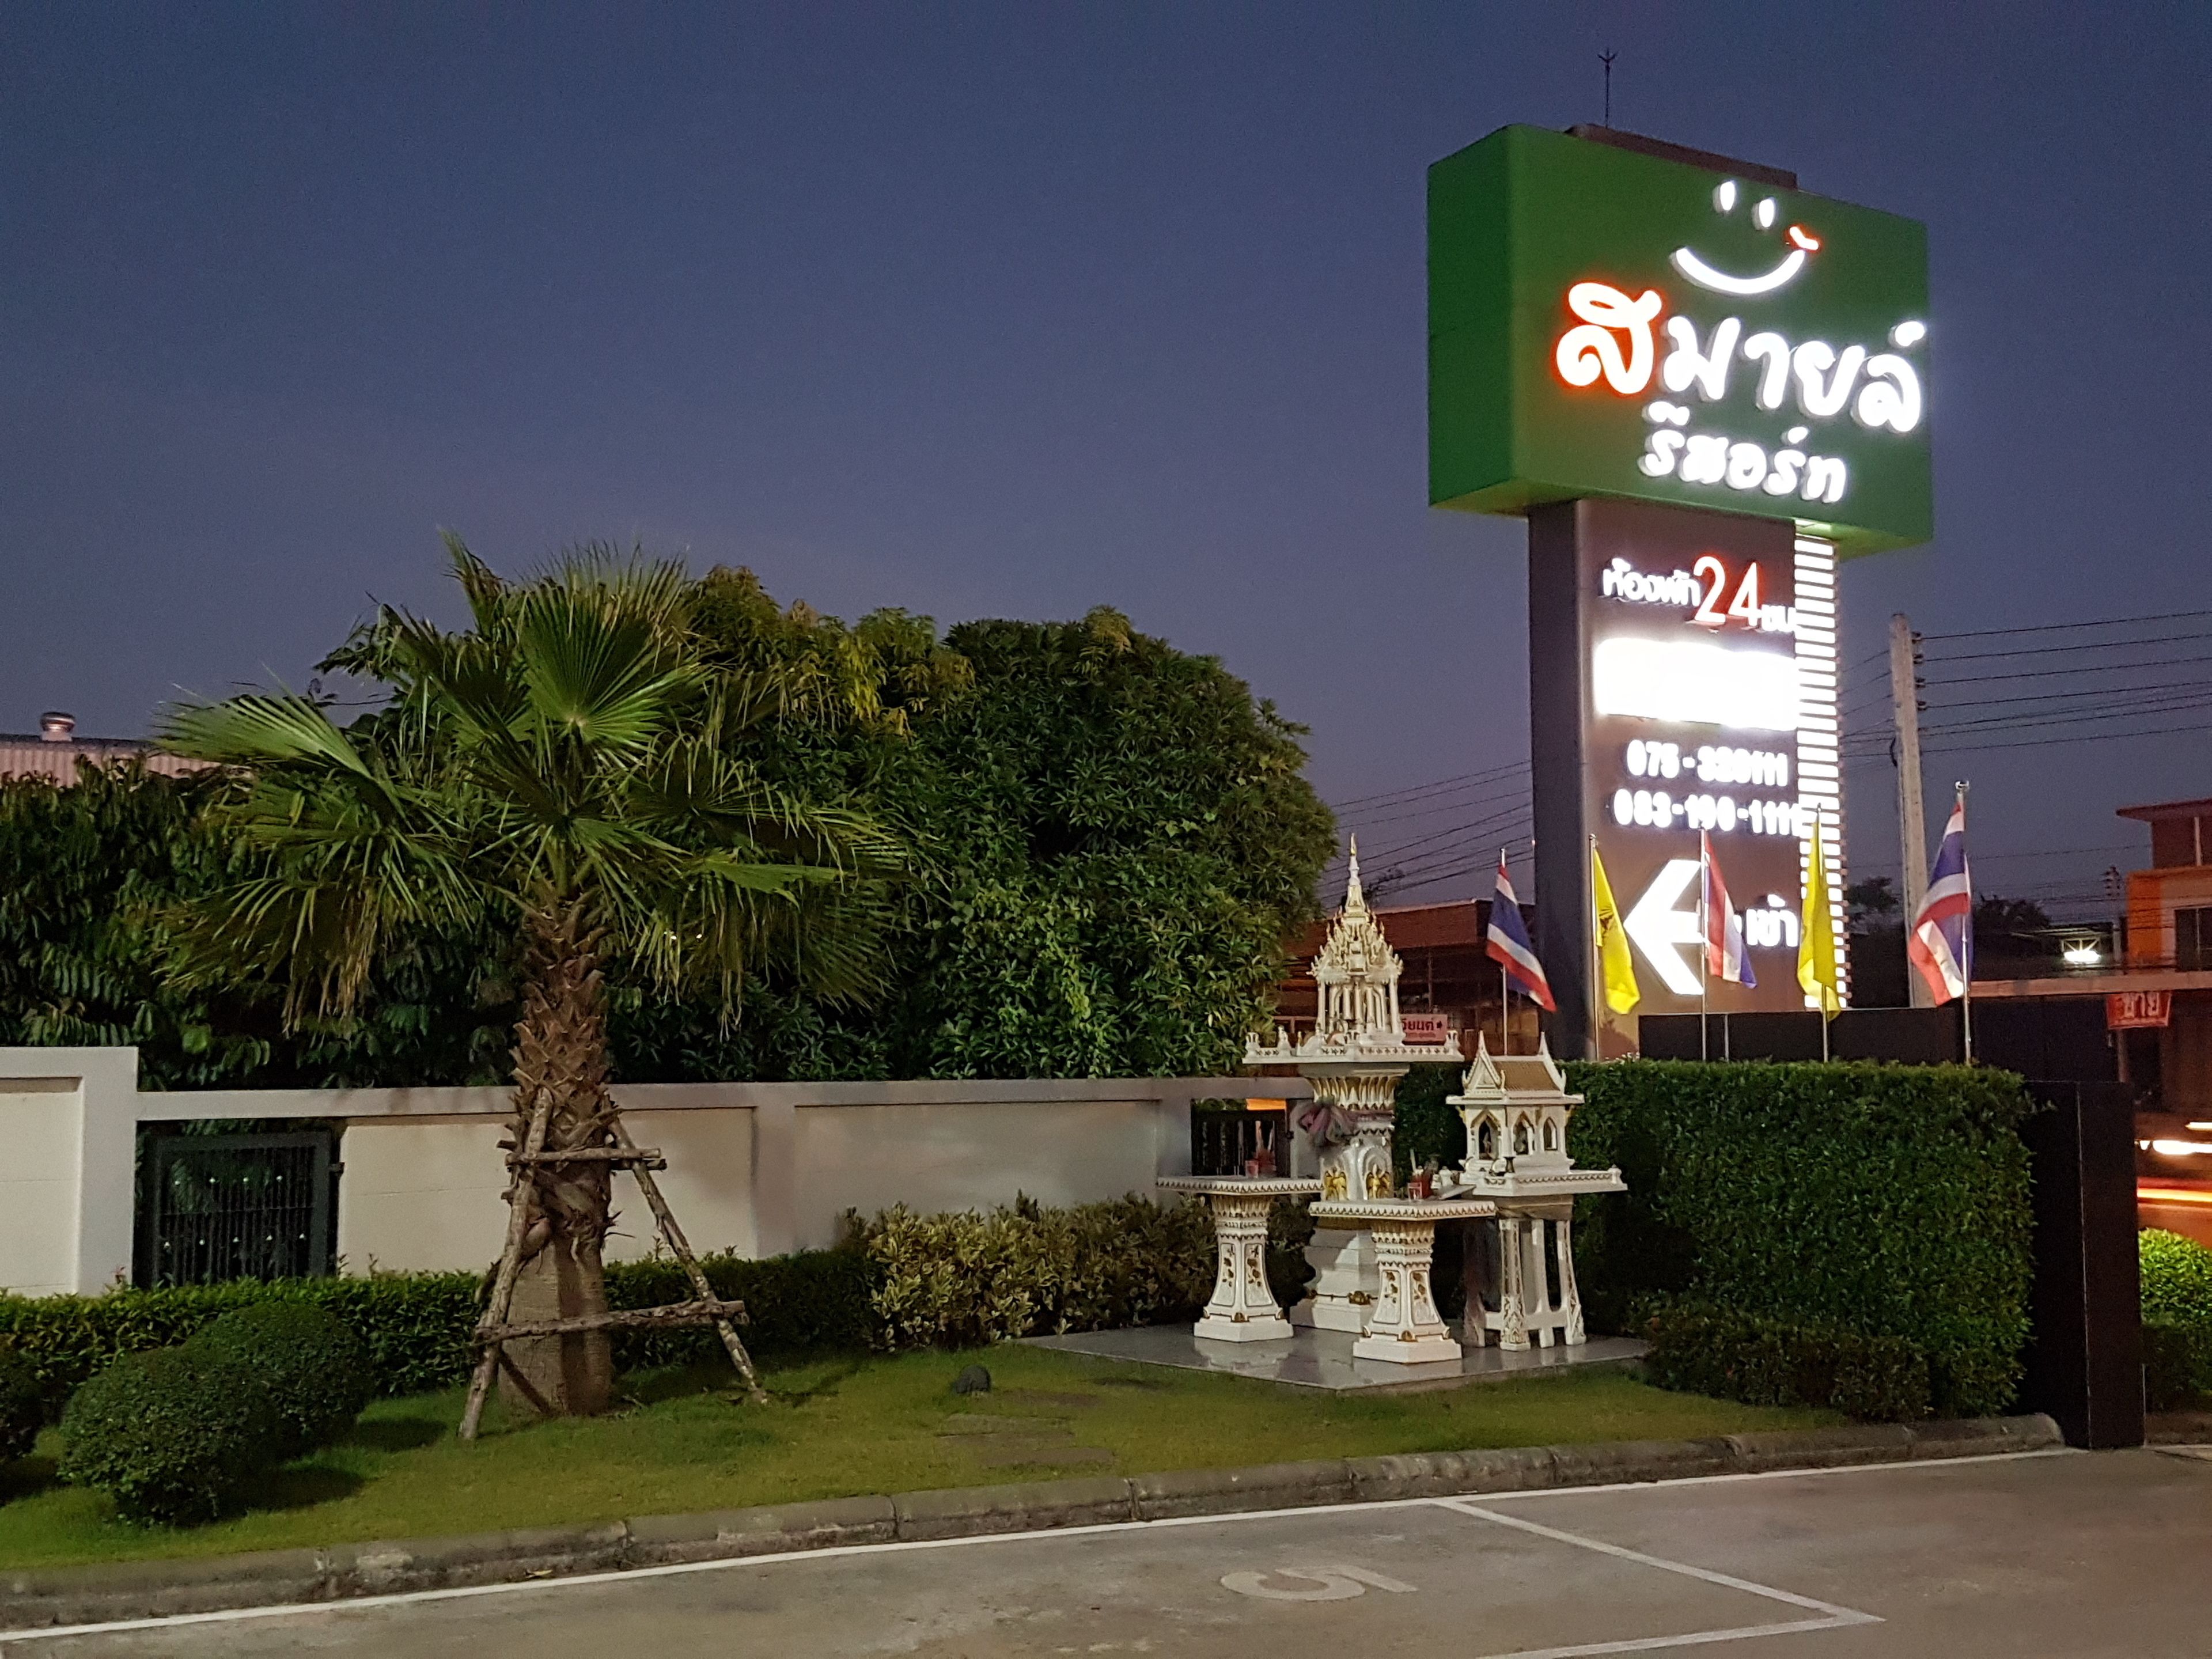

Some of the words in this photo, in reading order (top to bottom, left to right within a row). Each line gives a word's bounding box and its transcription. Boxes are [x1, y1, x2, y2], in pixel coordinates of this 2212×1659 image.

[1555, 281, 1927, 433] สมายล์
[1639, 400, 1848, 503] รีสอร์ท
